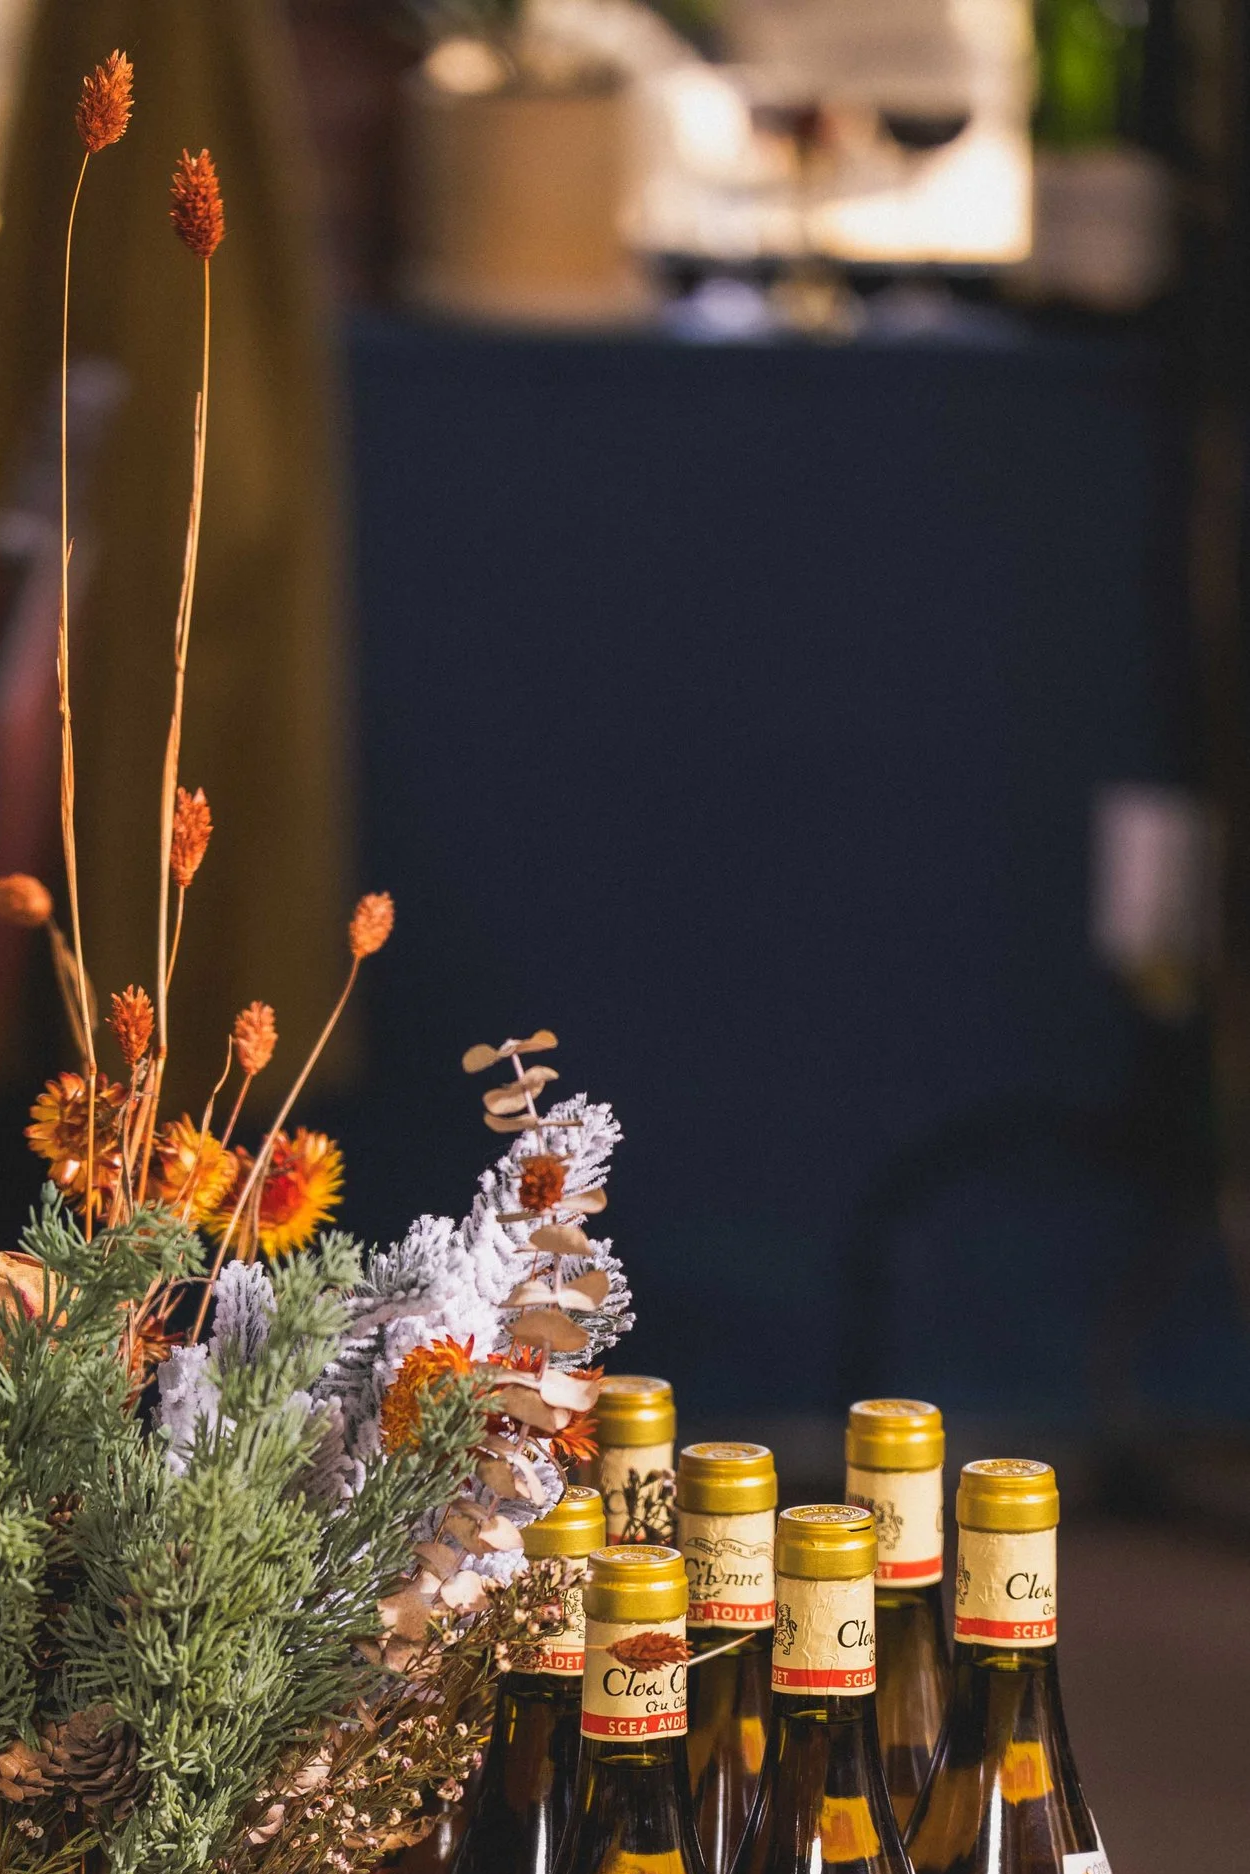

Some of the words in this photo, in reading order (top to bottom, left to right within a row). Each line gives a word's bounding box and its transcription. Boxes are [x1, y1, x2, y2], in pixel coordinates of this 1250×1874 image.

[1014, 1626, 1047, 1638] SCEA
[845, 1672, 873, 1687] SCEA
[608, 1720, 648, 1734] SCEA
